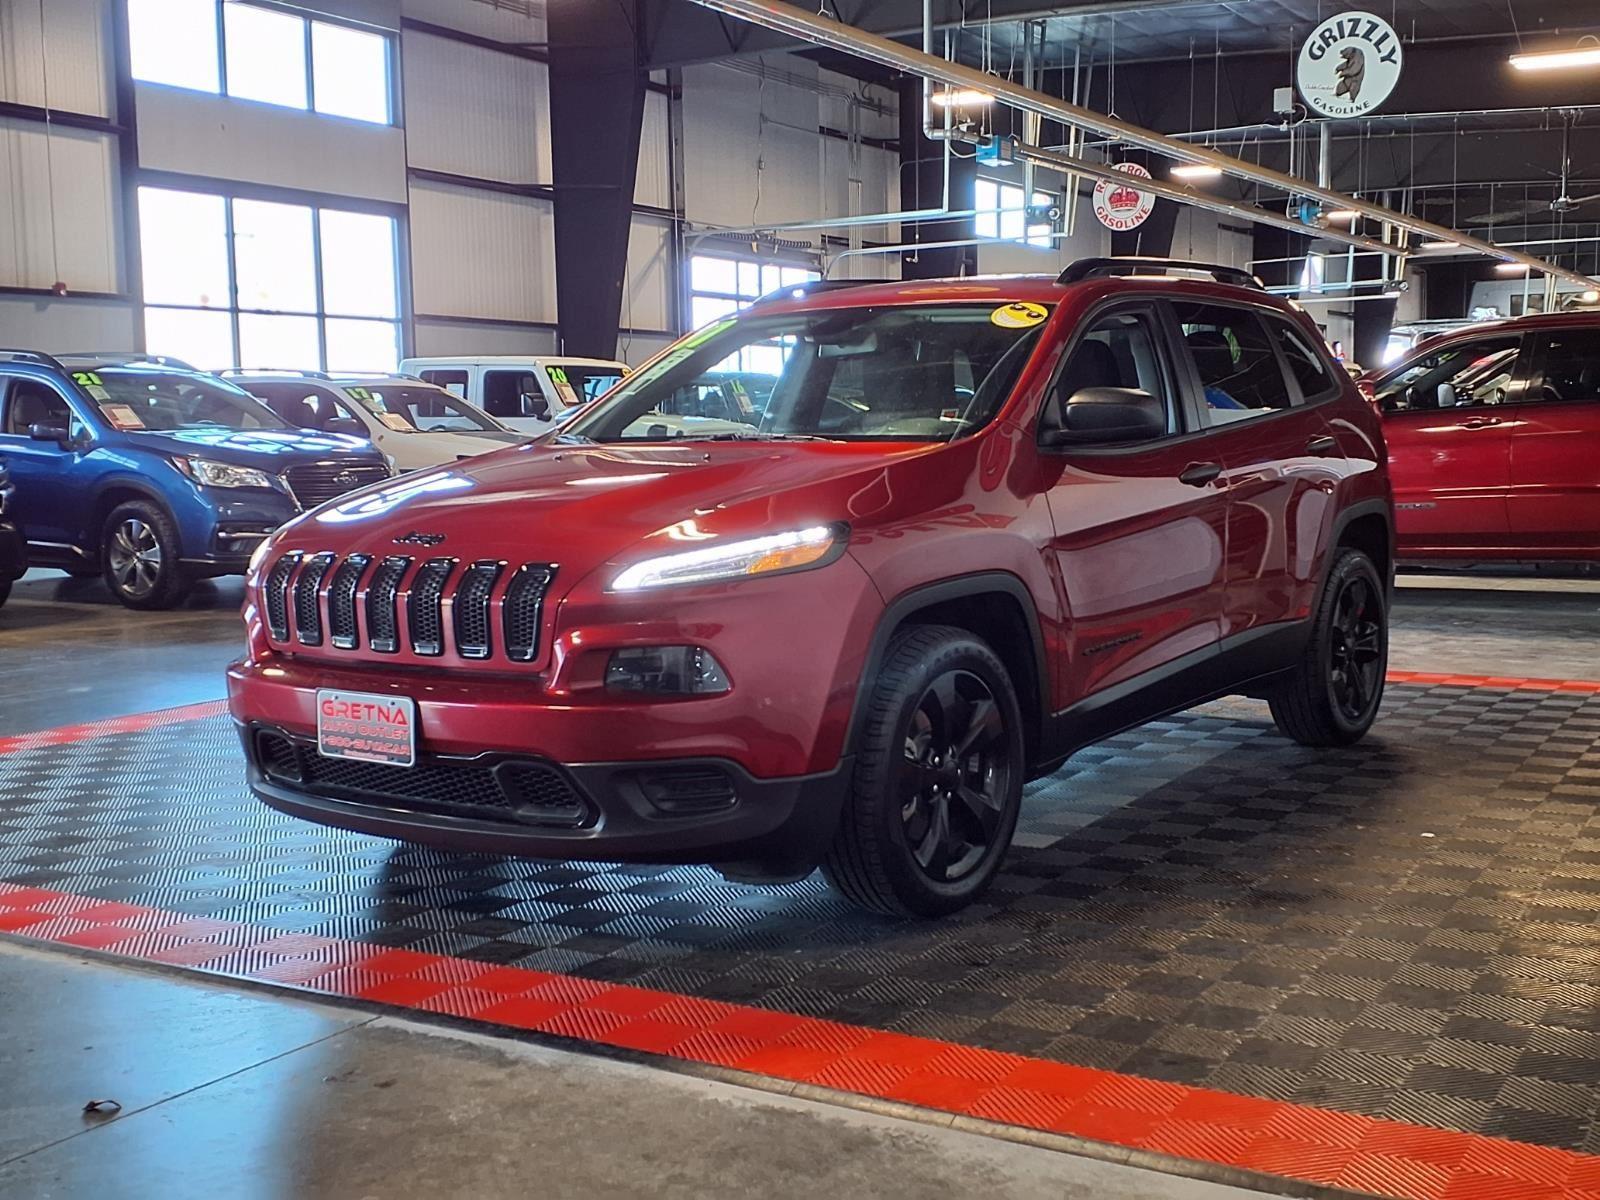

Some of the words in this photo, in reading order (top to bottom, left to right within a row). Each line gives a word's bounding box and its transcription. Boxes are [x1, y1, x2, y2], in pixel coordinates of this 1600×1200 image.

[1308, 17, 1397, 65] GRIZZLY
[1313, 97, 1370, 114] GASOLINE
[1097, 204, 1150, 228] GASOLINE
[72, 372, 103, 385] 21
[546, 367, 568, 384] 20
[321, 700, 409, 725] GRETNA
[359, 725, 409, 740] OUTLET
